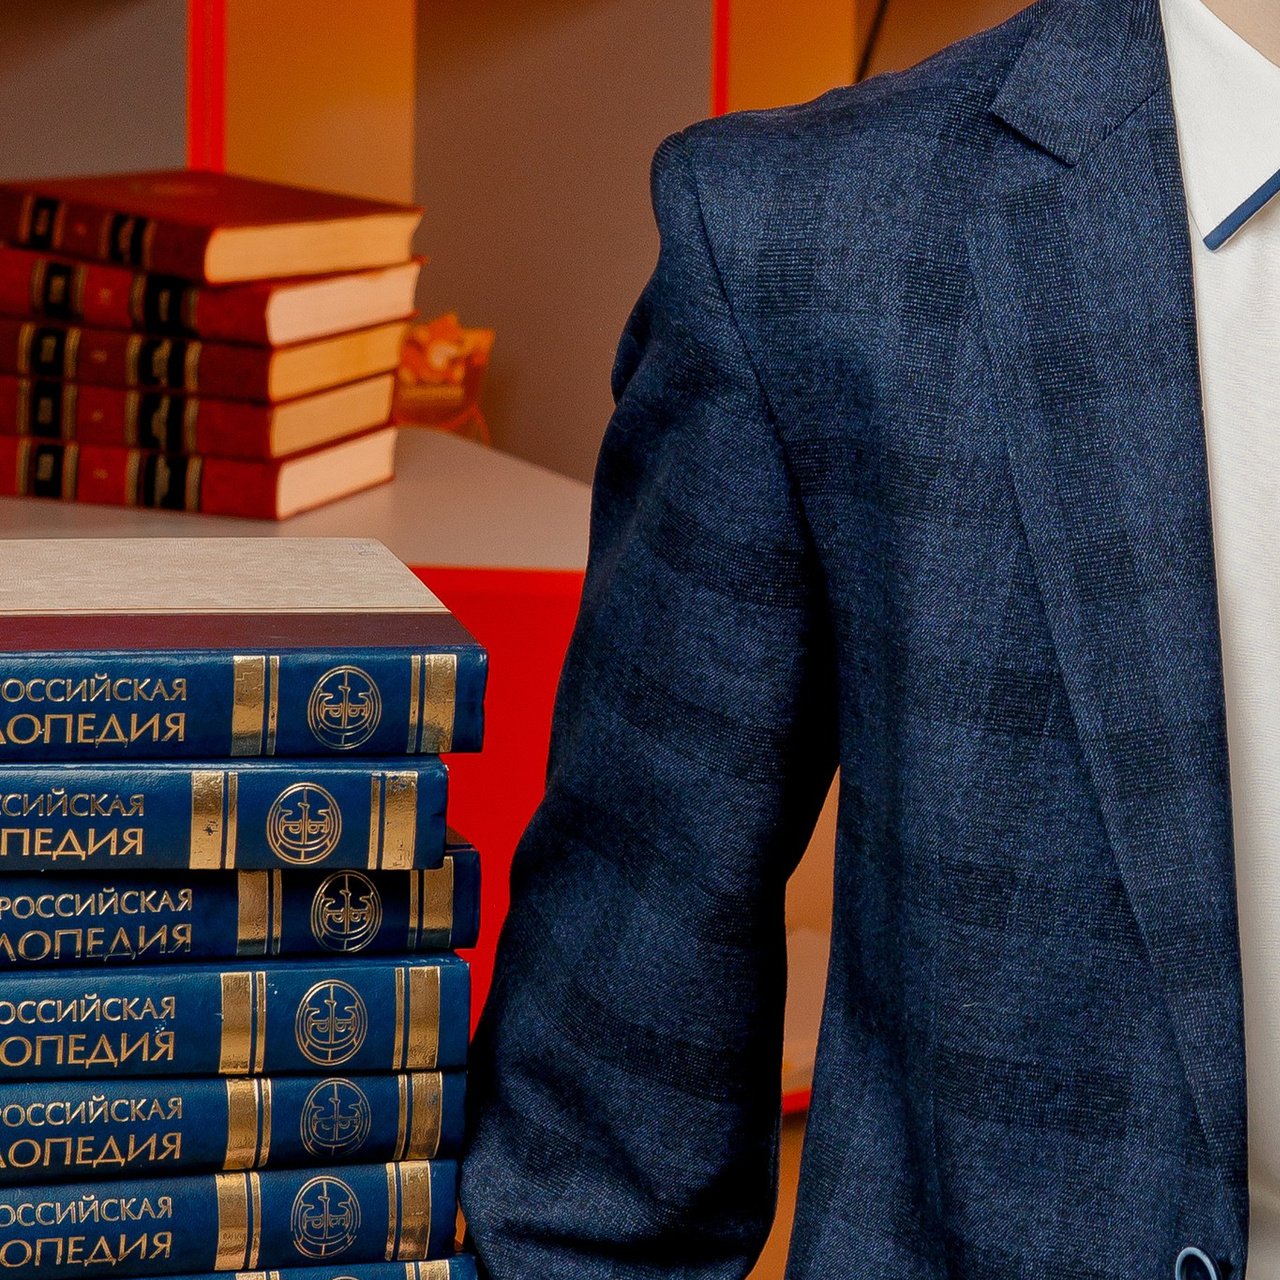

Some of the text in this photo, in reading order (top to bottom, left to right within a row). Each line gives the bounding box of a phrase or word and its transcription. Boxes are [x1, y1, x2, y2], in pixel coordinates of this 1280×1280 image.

[0, 672, 187, 703] ОССИЙСКАЯ
[0, 787, 145, 817] СИЙСКАЯ
[1, 827, 144, 861] ПЕДИЯ
[0, 1031, 175, 1069] ОПЕДИЯ
[0, 1095, 183, 1128] ОССИЙСКАЯ
[0, 1231, 172, 1268] ОПЕДИЯ
